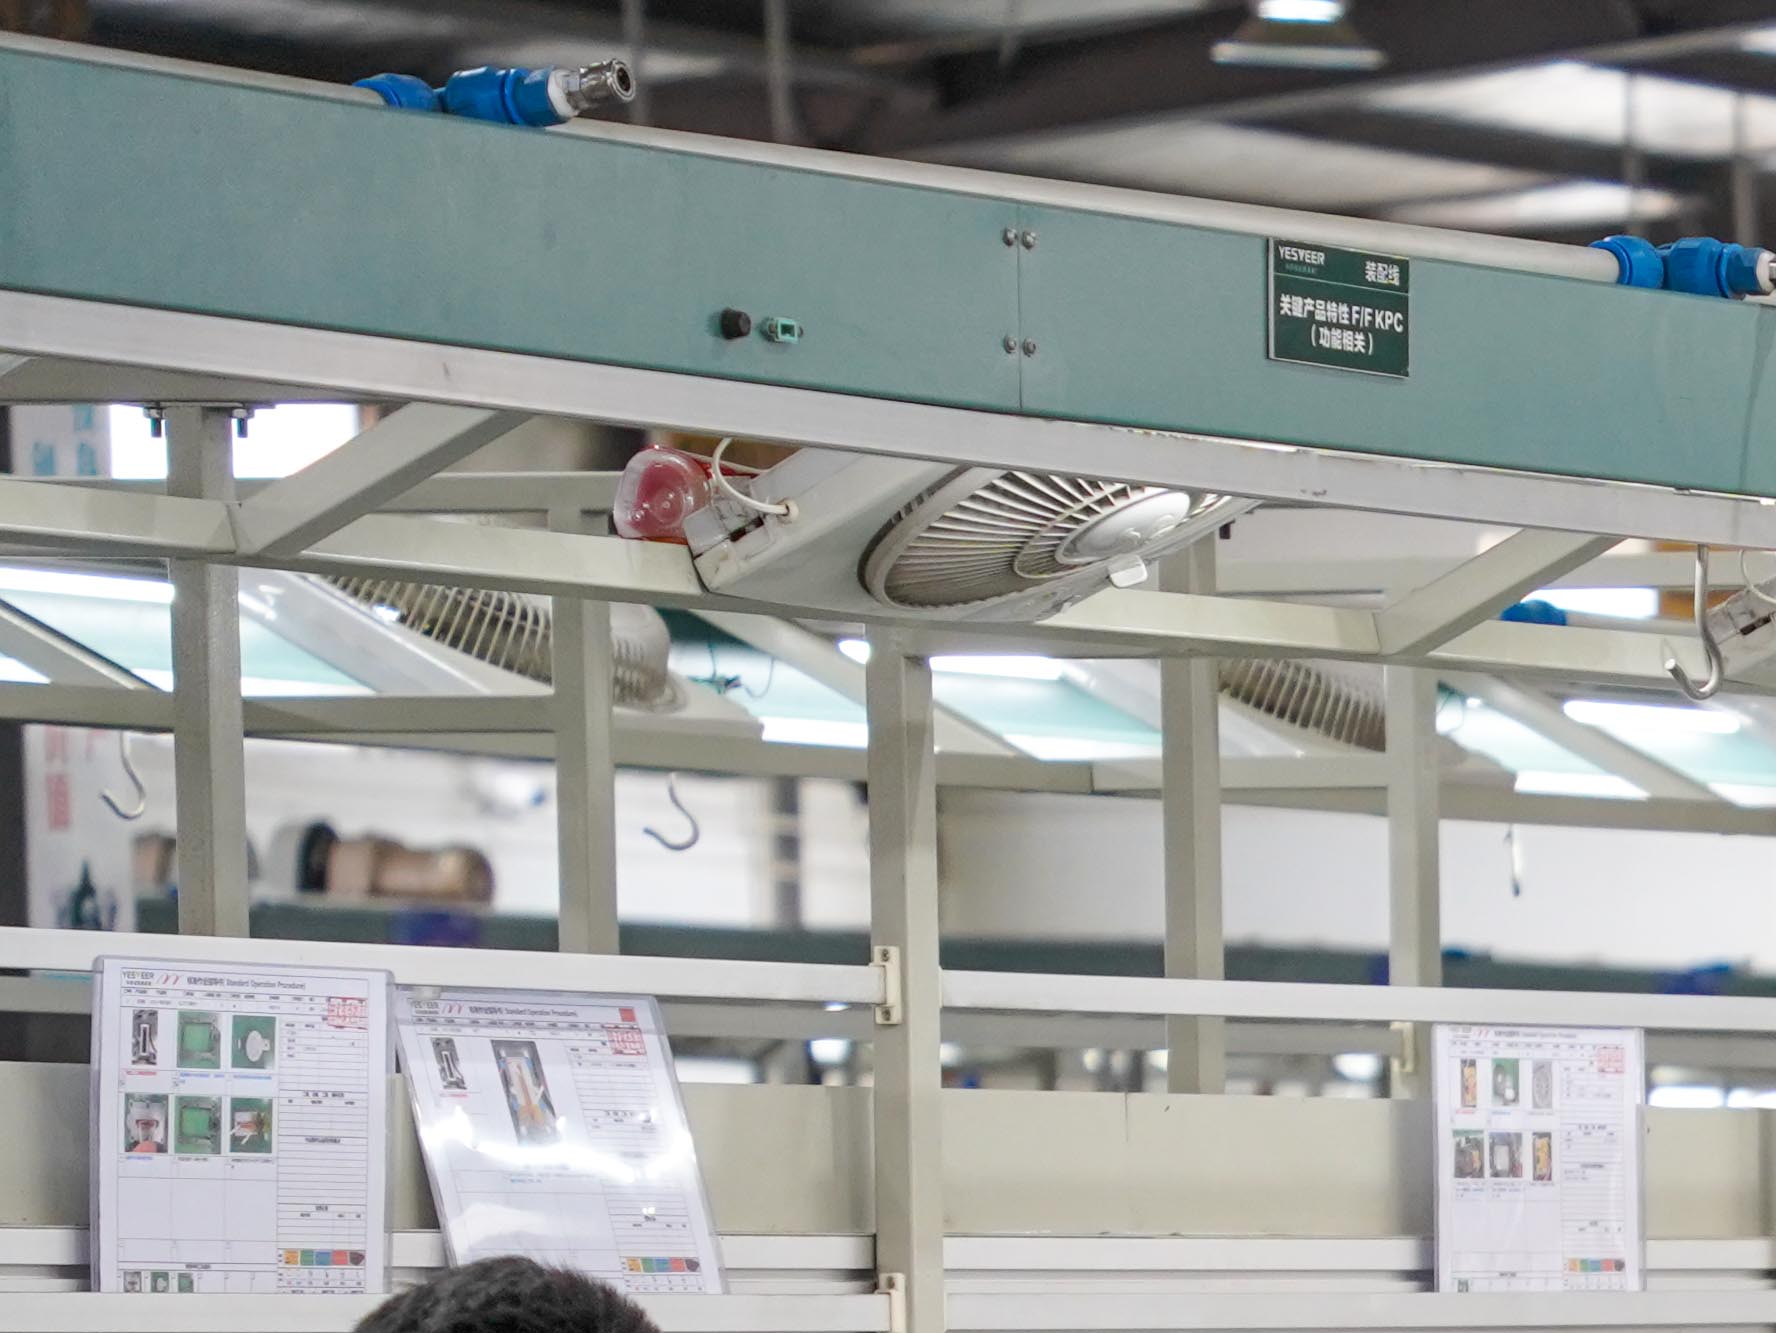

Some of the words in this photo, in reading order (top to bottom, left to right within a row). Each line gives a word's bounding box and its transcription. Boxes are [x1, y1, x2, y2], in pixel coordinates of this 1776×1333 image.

[1364, 261, 1400, 286] 装配线
[1279, 293, 1350, 325] 关键产品特性
[1351, 305, 1373, 328] F/F
[1375, 310, 1404, 333] KPC
